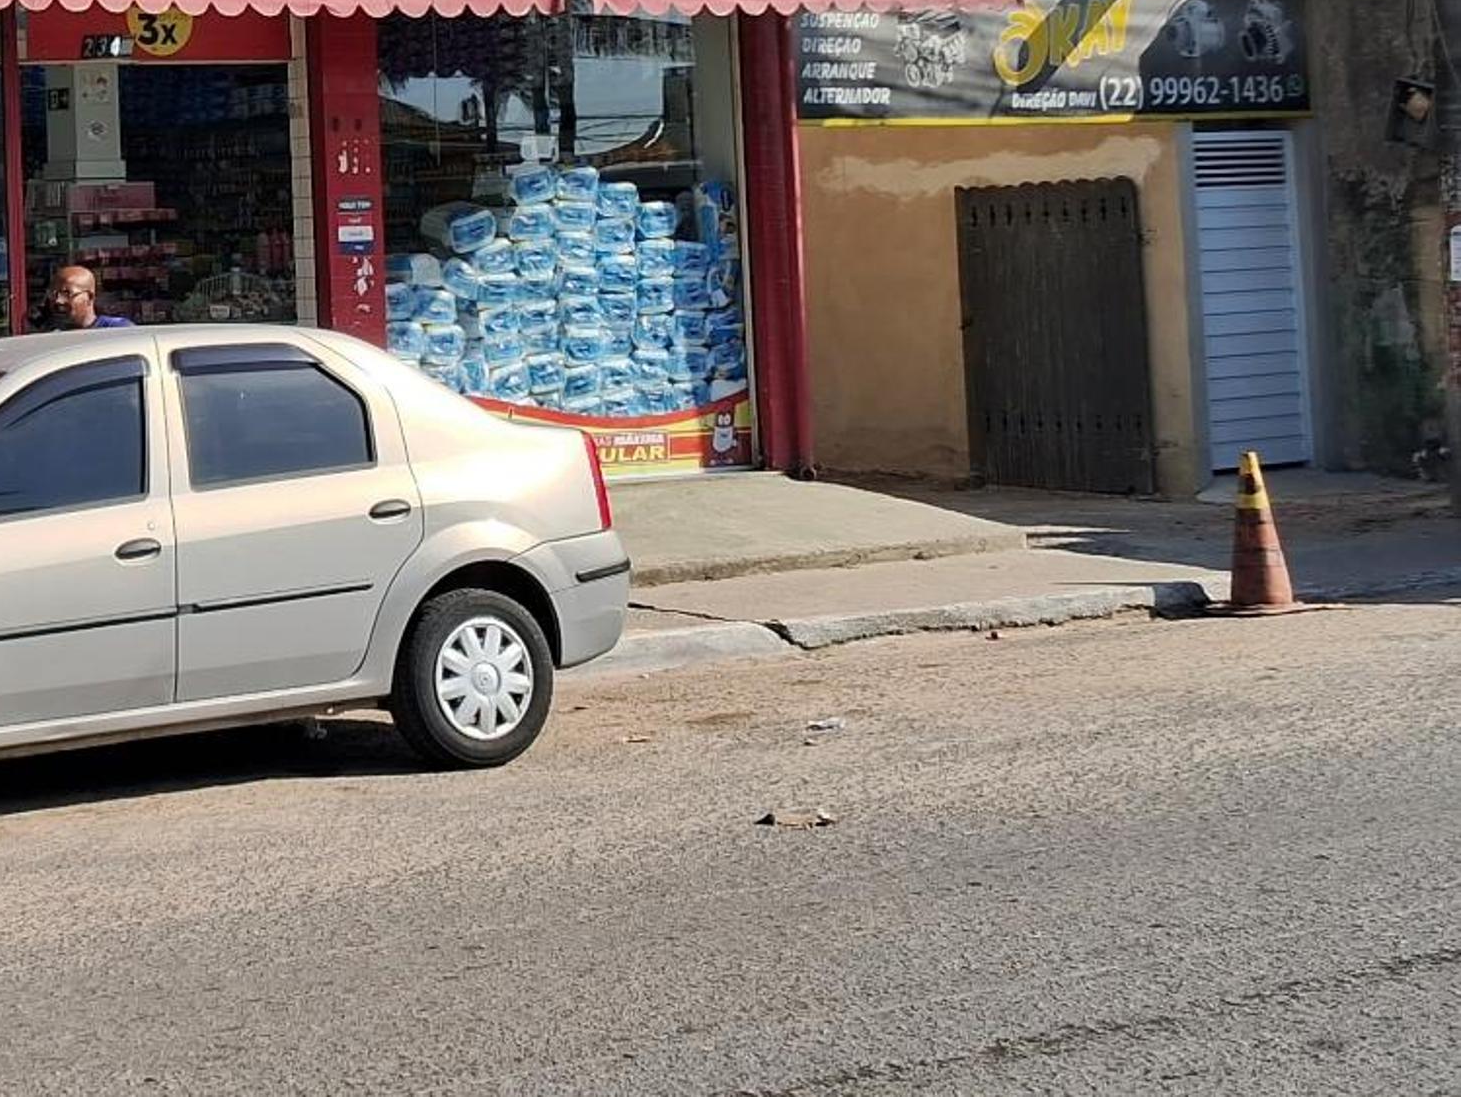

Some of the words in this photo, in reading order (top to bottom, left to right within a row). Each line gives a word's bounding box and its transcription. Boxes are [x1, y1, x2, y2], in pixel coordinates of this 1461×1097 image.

[801, 61, 877, 80] ARRANQUE
[803, 86, 892, 104] ALTERNADOR
[1099, 75, 1144, 111] (22)
[1149, 75, 1284, 106] 99962-1436
[600, 445, 666, 464] ULAR
